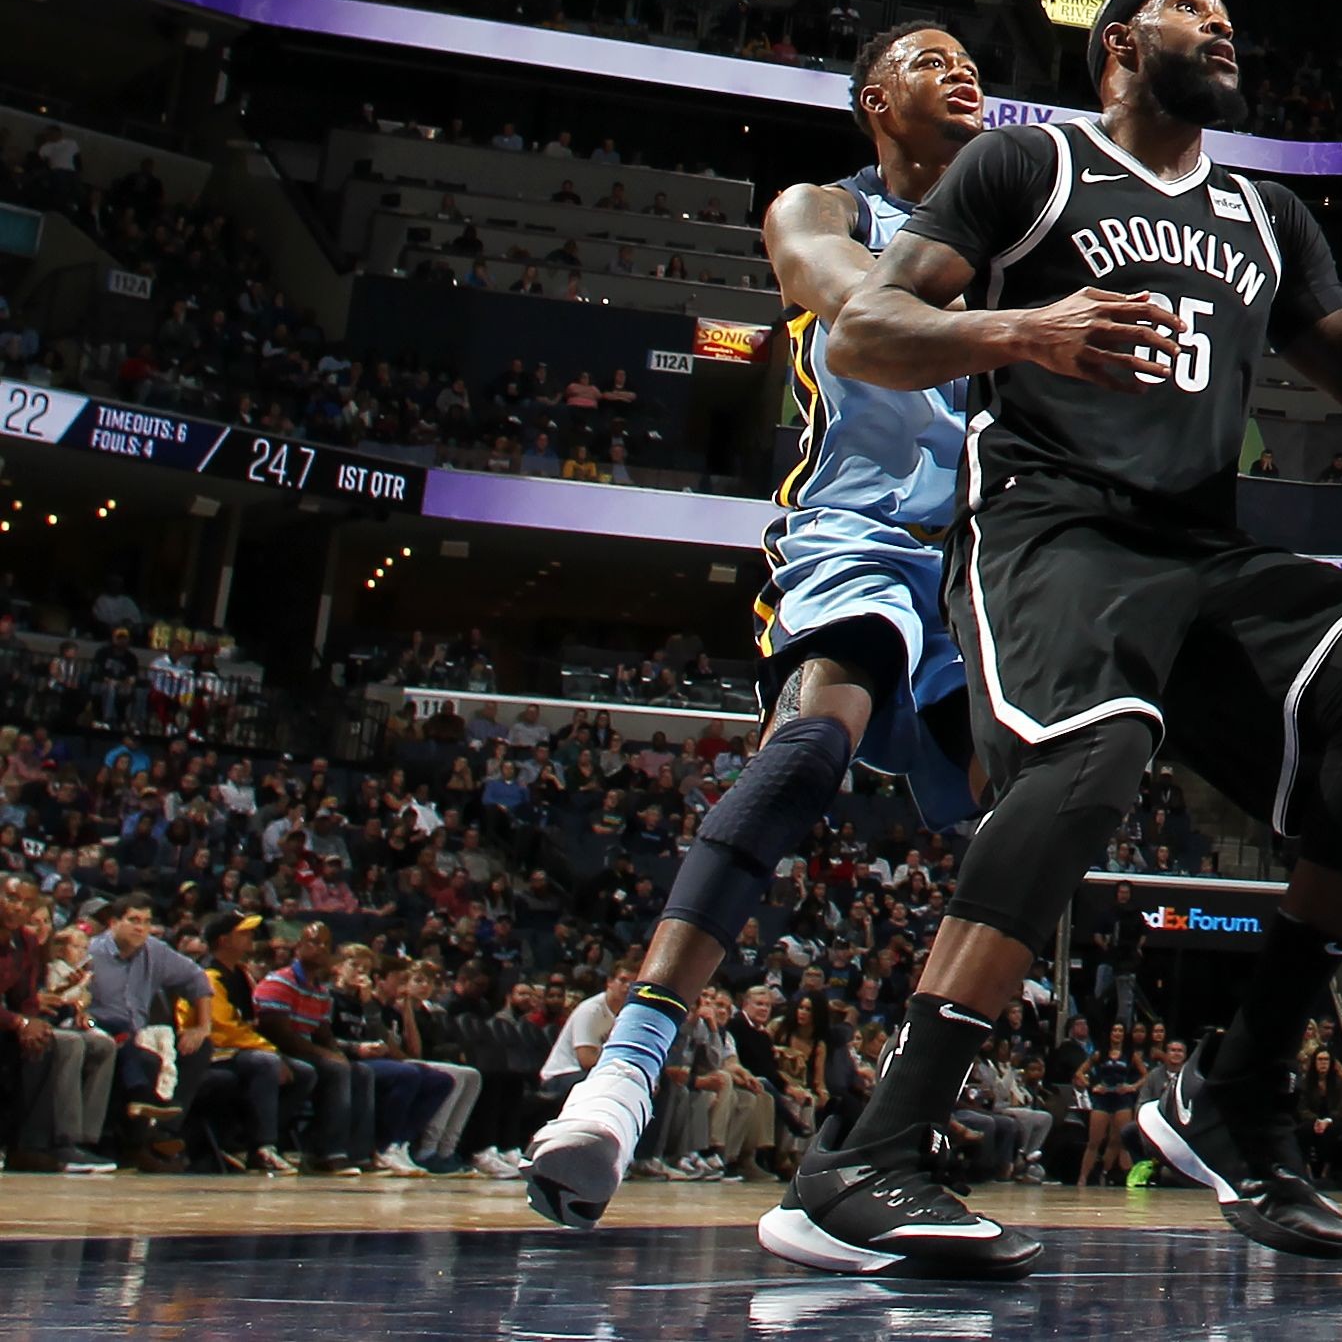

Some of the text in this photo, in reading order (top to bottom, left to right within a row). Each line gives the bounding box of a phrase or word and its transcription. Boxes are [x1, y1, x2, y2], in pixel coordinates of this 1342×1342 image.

[1061, 5, 1094, 20] RIVE
[1072, 216, 1266, 306] BROOKLYN
[701, 327, 752, 346] SONIC
[655, 353, 689, 371] 112A
[4, 388, 50, 438] 22
[97, 406, 187, 442] TIMEOUTS: 6
[91, 428, 154, 458] FOULS: 4
[248, 437, 316, 490] 24.7
[369, 470, 406, 502] QTR
[1143, 907, 1263, 935] dExForum.
